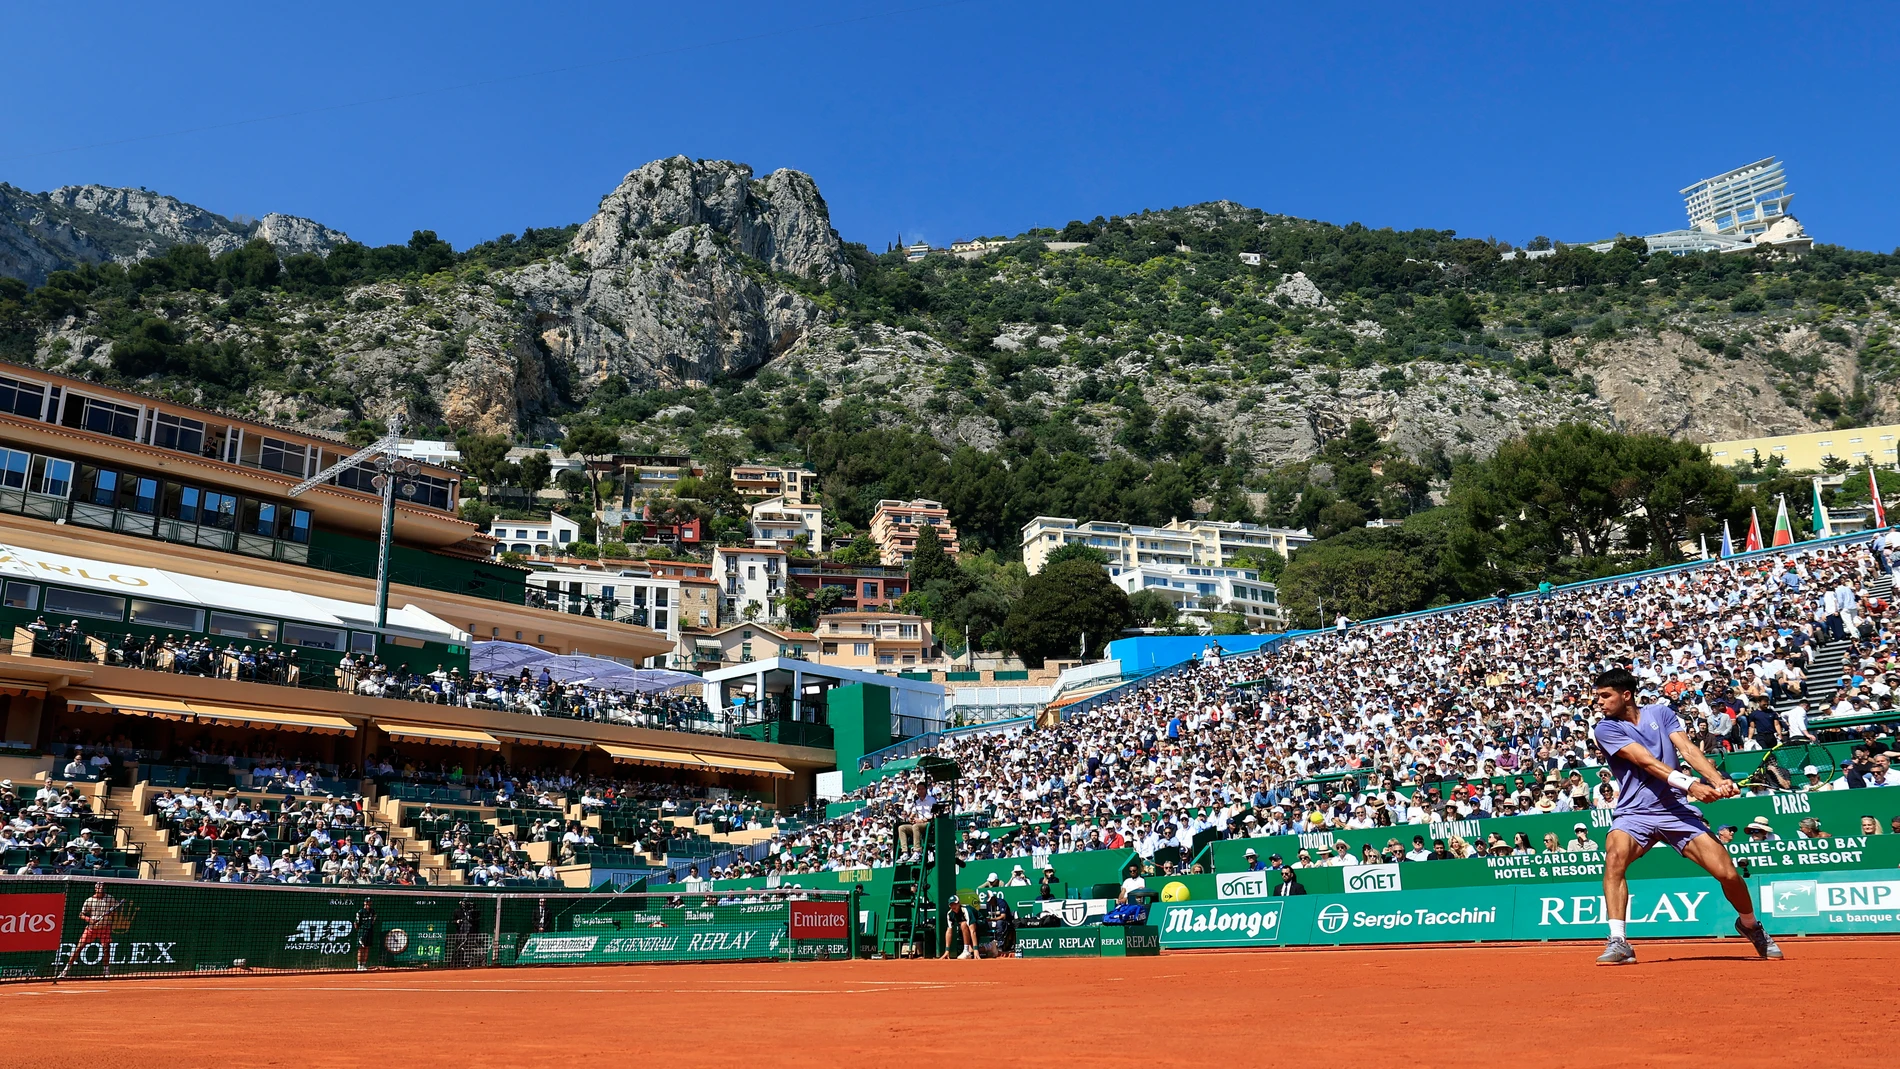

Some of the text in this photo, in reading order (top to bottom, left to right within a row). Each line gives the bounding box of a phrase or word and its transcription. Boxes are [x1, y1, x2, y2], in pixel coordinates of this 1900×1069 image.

[1772, 793, 1811, 815] PARIS
[1429, 819, 1481, 840] CINCINNATI
[1297, 831, 1334, 850] TORONTO
[1834, 836, 1868, 849] BAY
[1032, 854, 1050, 870] ROME
[1487, 852, 1577, 868] MONTE-CARLO
[1781, 854, 1794, 866] &
[1797, 851, 1863, 865] RESORT
[838, 869, 872, 883] MONTE-CARLO
[1494, 864, 1605, 879] HOTEL & RESORT
[1827, 886, 1892, 907] BNP
[746, 903, 784, 913] DUNLOP
[1538, 891, 1710, 926] RELAY
[793, 911, 846, 928] Emirates
[1165, 906, 1278, 938] Malongo
[1352, 906, 1496, 930] Sergio Tacchini
[1829, 913, 1843, 923] La
[1846, 912, 1892, 924] banque
[285, 920, 353, 942] ATP
[284, 942, 351, 955] MASTERS 1000
[621, 936, 679, 953] GENERALI
[687, 930, 758, 952] REPLAY
[1019, 937, 1096, 950] REPLAY REPLAY
[1101, 938, 1124, 946] REPLAY
[1126, 935, 1158, 949] REPLAY
[51, 941, 177, 966] ROLEX
[417, 945, 441, 957] 0:34
